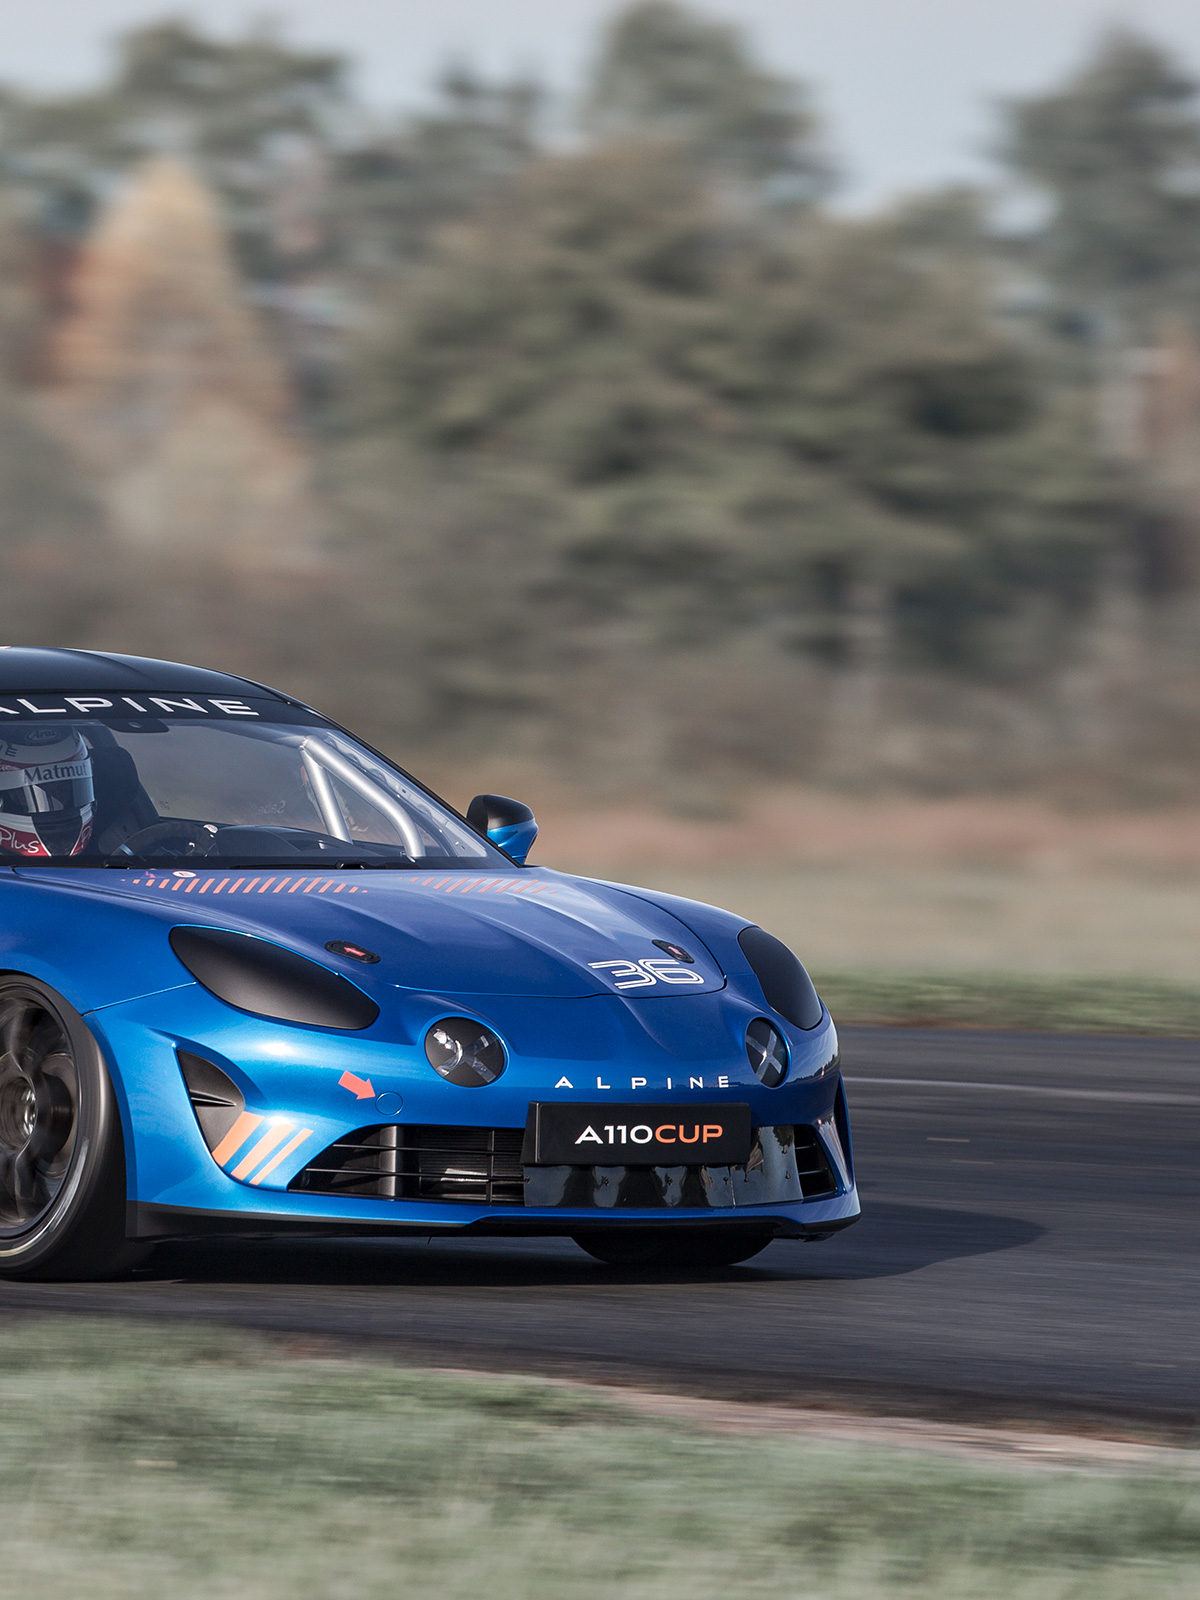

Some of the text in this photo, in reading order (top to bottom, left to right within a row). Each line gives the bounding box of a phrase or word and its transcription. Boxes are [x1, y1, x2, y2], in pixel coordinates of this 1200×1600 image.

[24, 763, 87, 784] Matmut
[587, 959, 704, 989] 36
[554, 1076, 729, 1089] ALPINE
[574, 1125, 723, 1144] A110CUP
